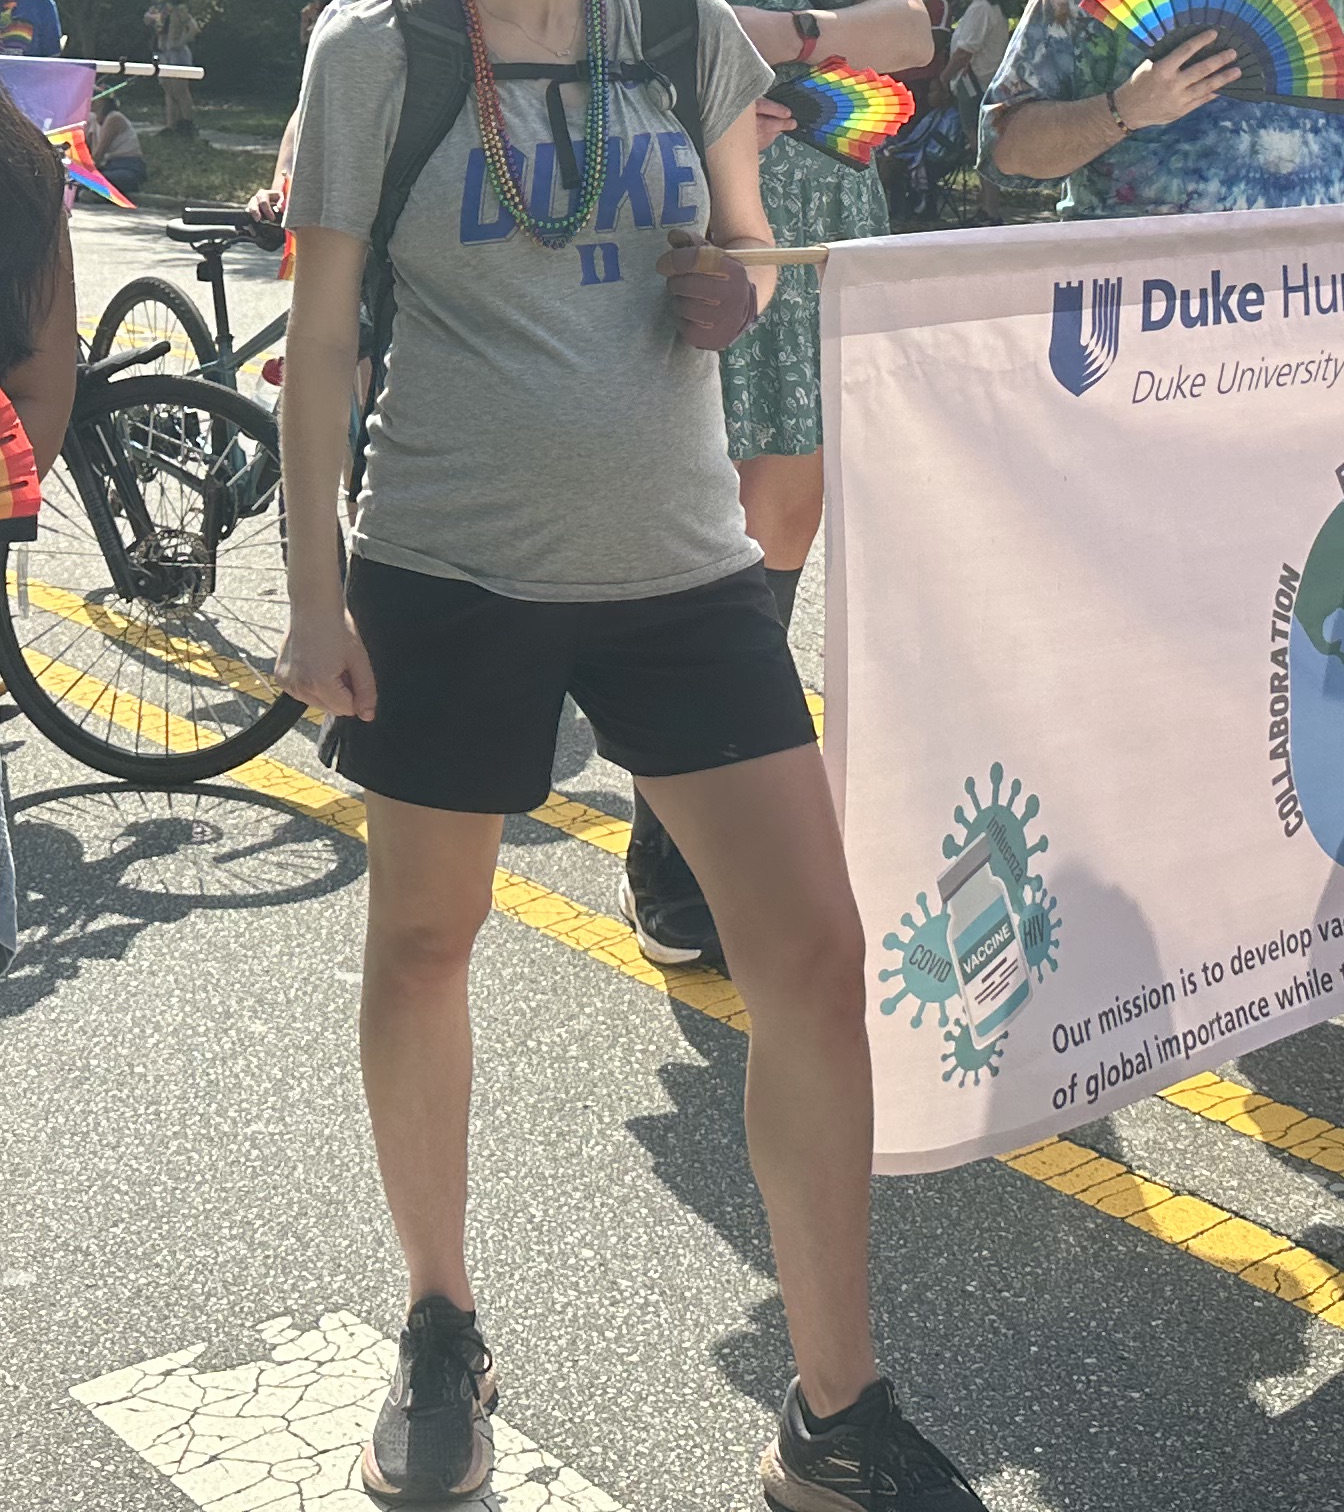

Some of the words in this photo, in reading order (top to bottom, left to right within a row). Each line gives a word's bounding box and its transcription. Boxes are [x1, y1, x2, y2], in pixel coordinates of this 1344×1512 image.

[460, 131, 699, 247] DUKE
[1141, 269, 1265, 332] Duke
[1131, 365, 1207, 404] Duke
[1268, 562, 1304, 838] COLLABORATION
[986, 813, 1025, 885] Influenza
[909, 943, 953, 983] COVID
[962, 922, 1012, 975] VACCINE
[1023, 912, 1047, 951] HIV
[1052, 1018, 1093, 1054] Our
[1098, 981, 1176, 1035] mission
[1179, 967, 1197, 998] is
[1201, 961, 1225, 987] to
[1229, 929, 1313, 976] develop
[1052, 1072, 1079, 1110] of
[1085, 1039, 1154, 1105] global
[1156, 995, 1269, 1061] importance
[1274, 970, 1333, 1011] while
